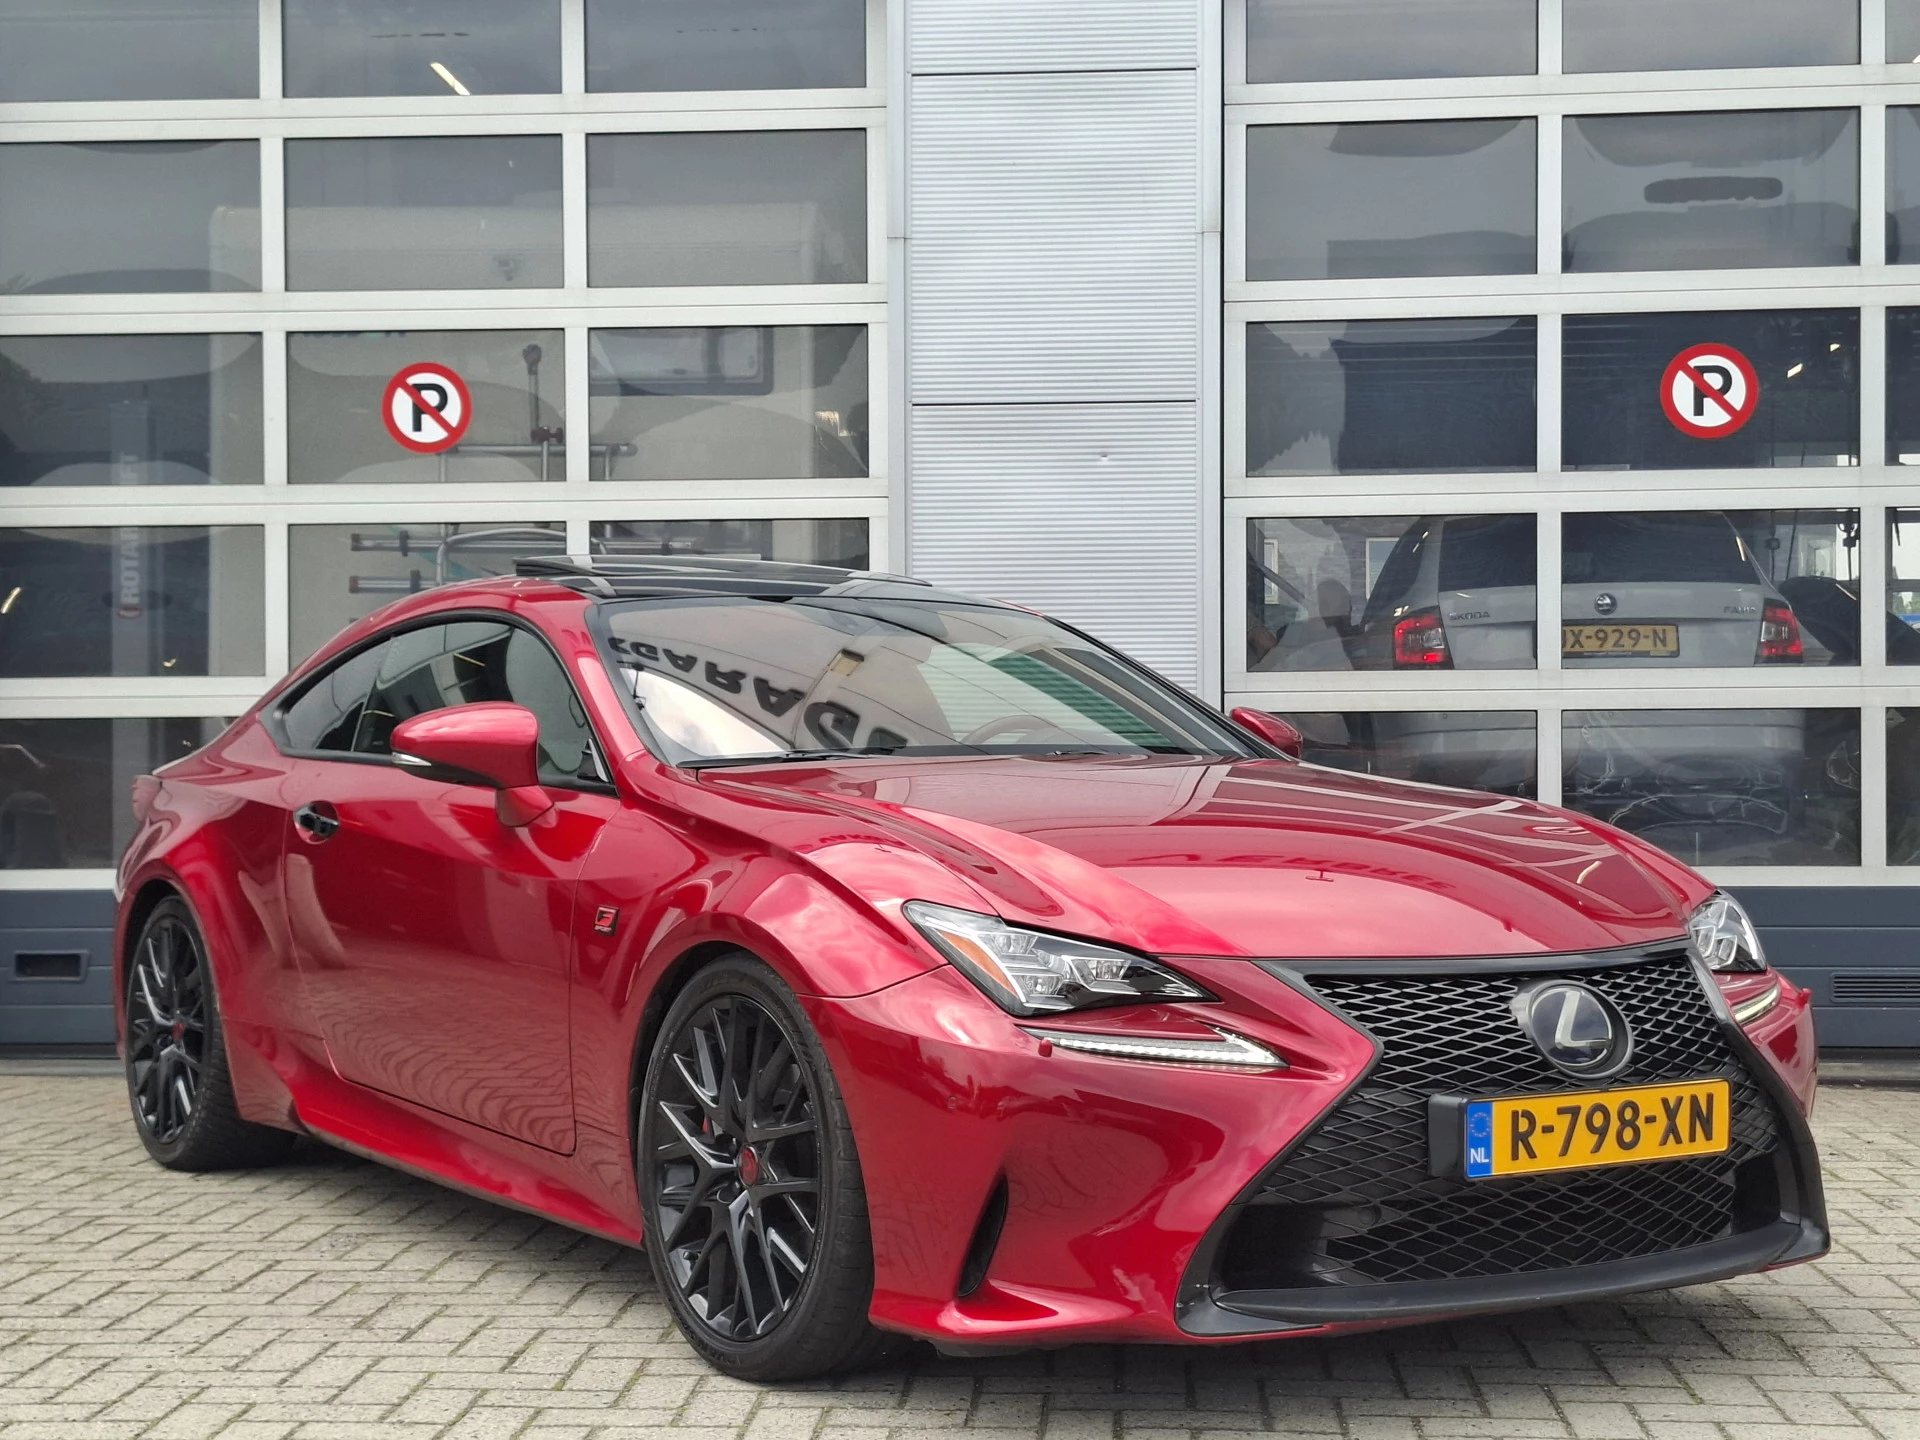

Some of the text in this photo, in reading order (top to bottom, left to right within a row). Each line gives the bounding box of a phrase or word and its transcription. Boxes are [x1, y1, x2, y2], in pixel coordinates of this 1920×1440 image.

[411, 383, 448, 432] P
[1693, 365, 1733, 417] P
[120, 526, 140, 604] ROTAR
[1511, 1092, 1715, 1162] R-798-XN
[1470, 1147, 1490, 1164] NL
